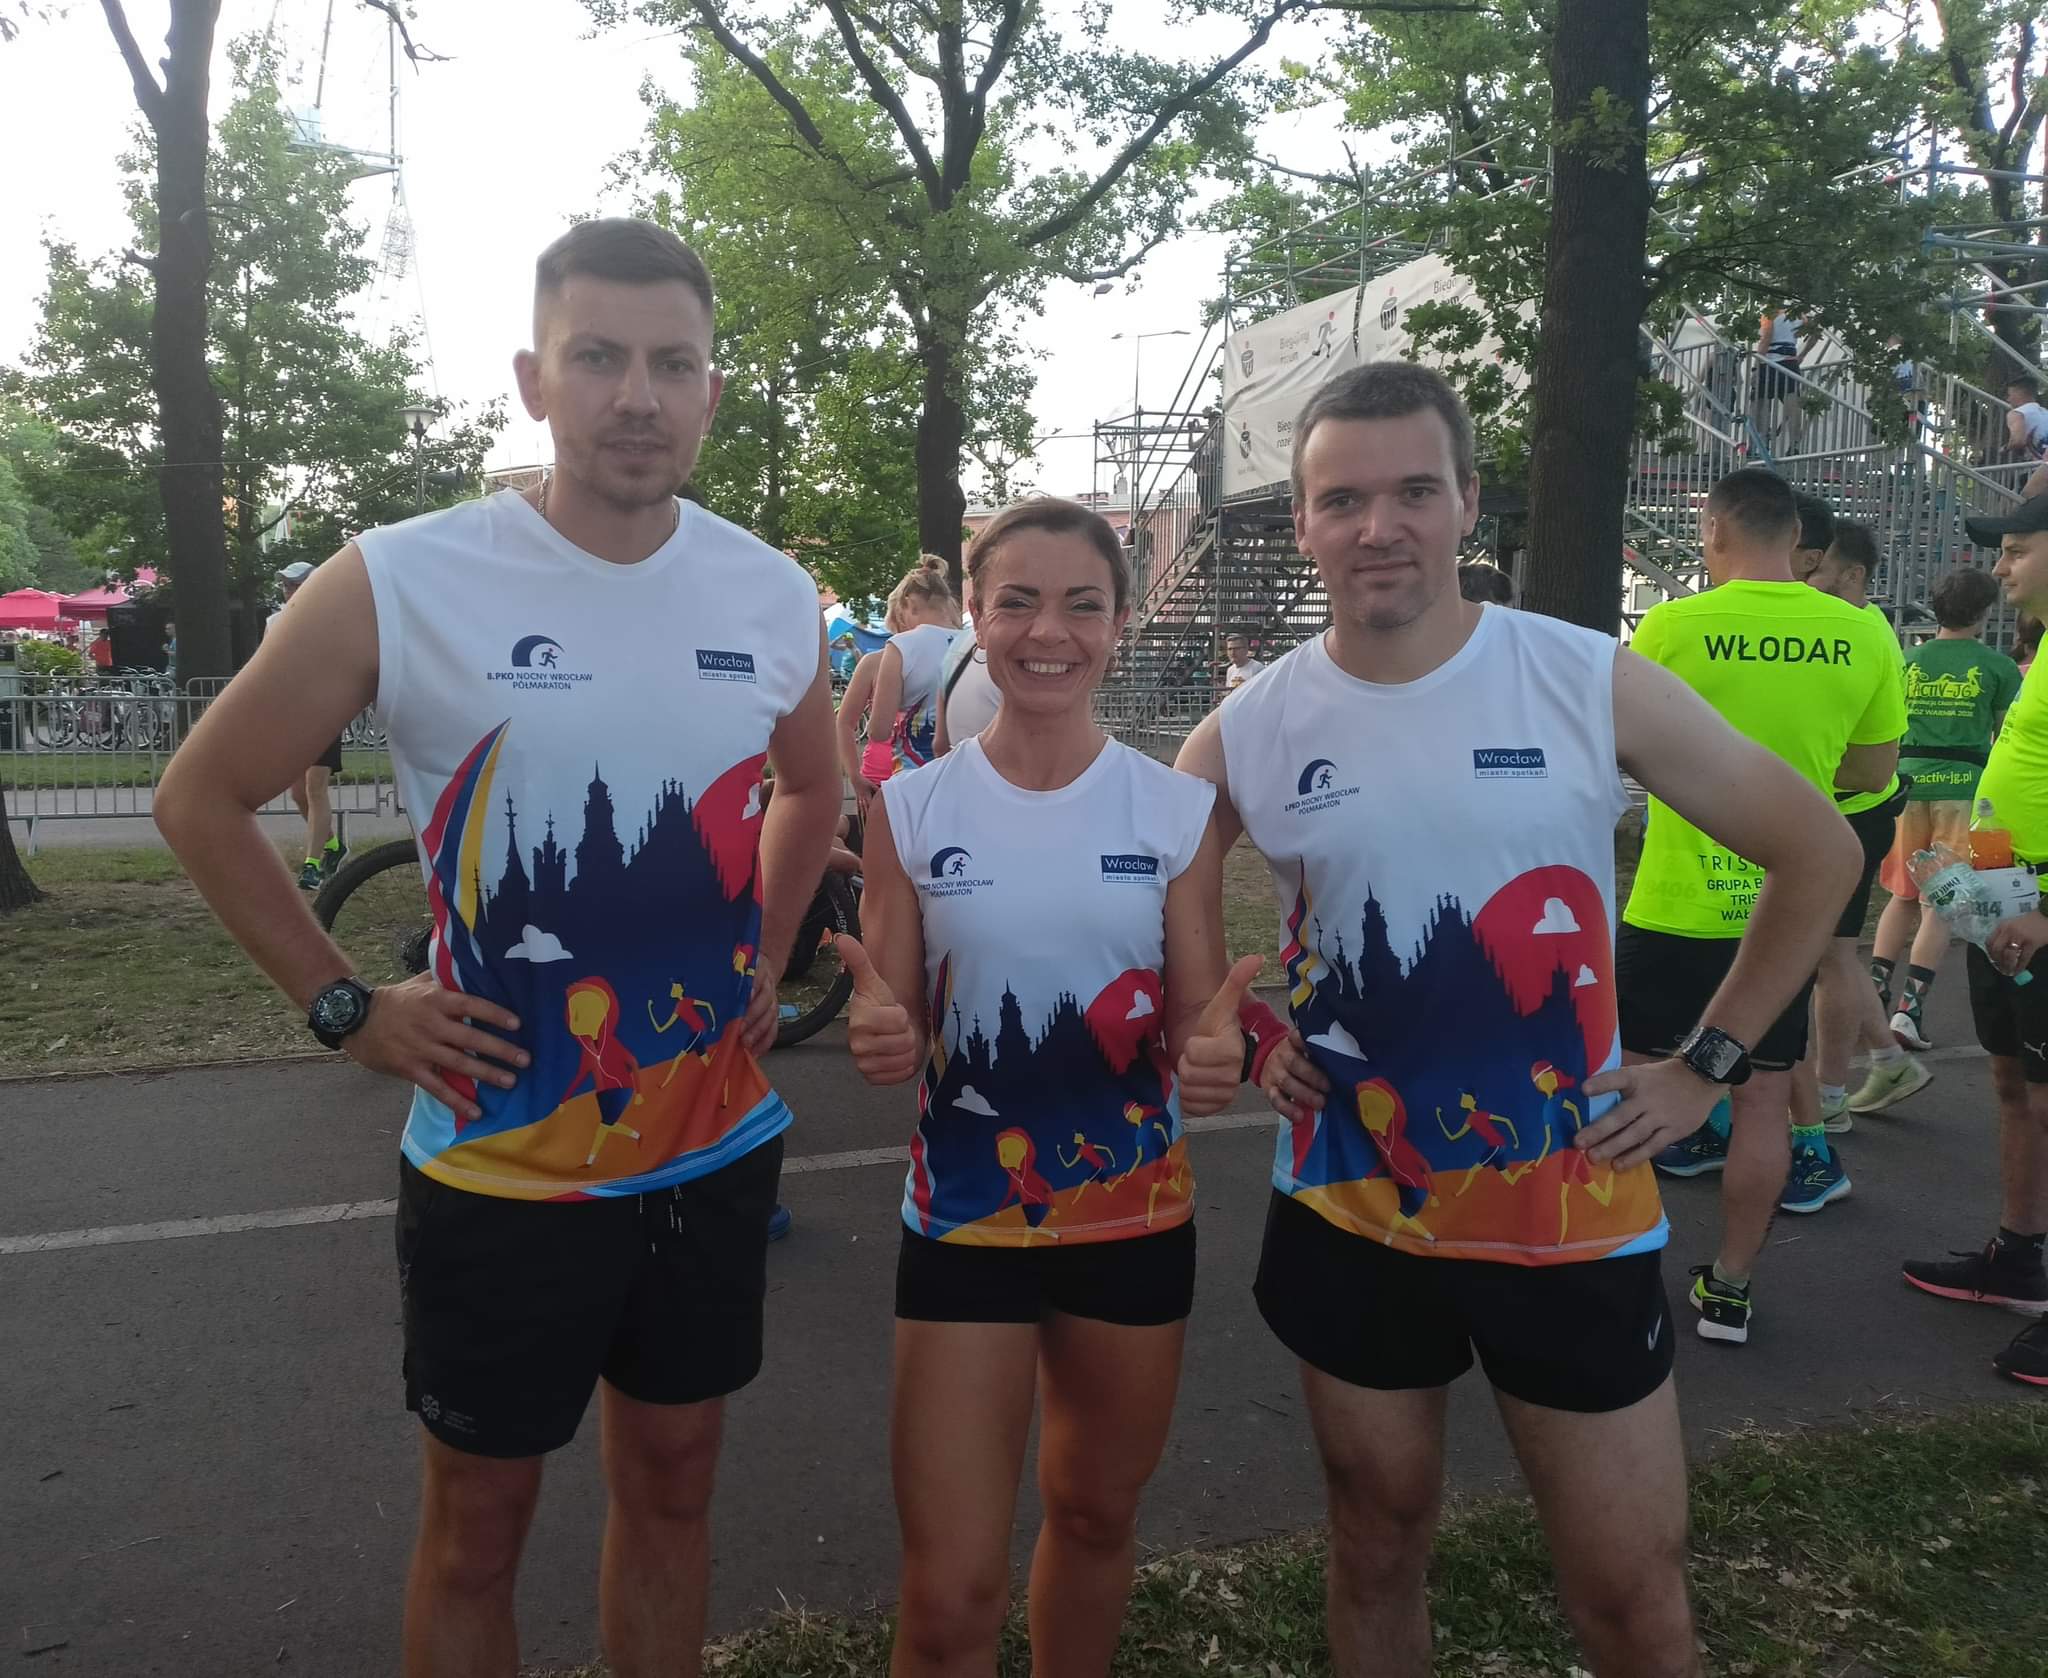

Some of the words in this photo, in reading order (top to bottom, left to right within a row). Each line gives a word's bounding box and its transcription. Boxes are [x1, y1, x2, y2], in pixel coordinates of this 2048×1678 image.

[1703, 634, 1852, 667] WŁODAR
[516, 672, 548, 681] NOCNY
[549, 672, 593, 682] WROCŁAW
[512, 680, 572, 690] PÓŁMARATON
[1478, 751, 1542, 765] Wrocław
[1479, 769, 1509, 777] miasto
[1301, 795, 1323, 807] NOCNY
[1324, 786, 1361, 800] WROCŁAW
[931, 881, 955, 890] NOCNY
[955, 879, 995, 888] WROCŁAW
[1706, 878, 1752, 892] GRUPA
[1730, 893, 1761, 906] TRIS
[1720, 909, 1750, 921] WAŁ
